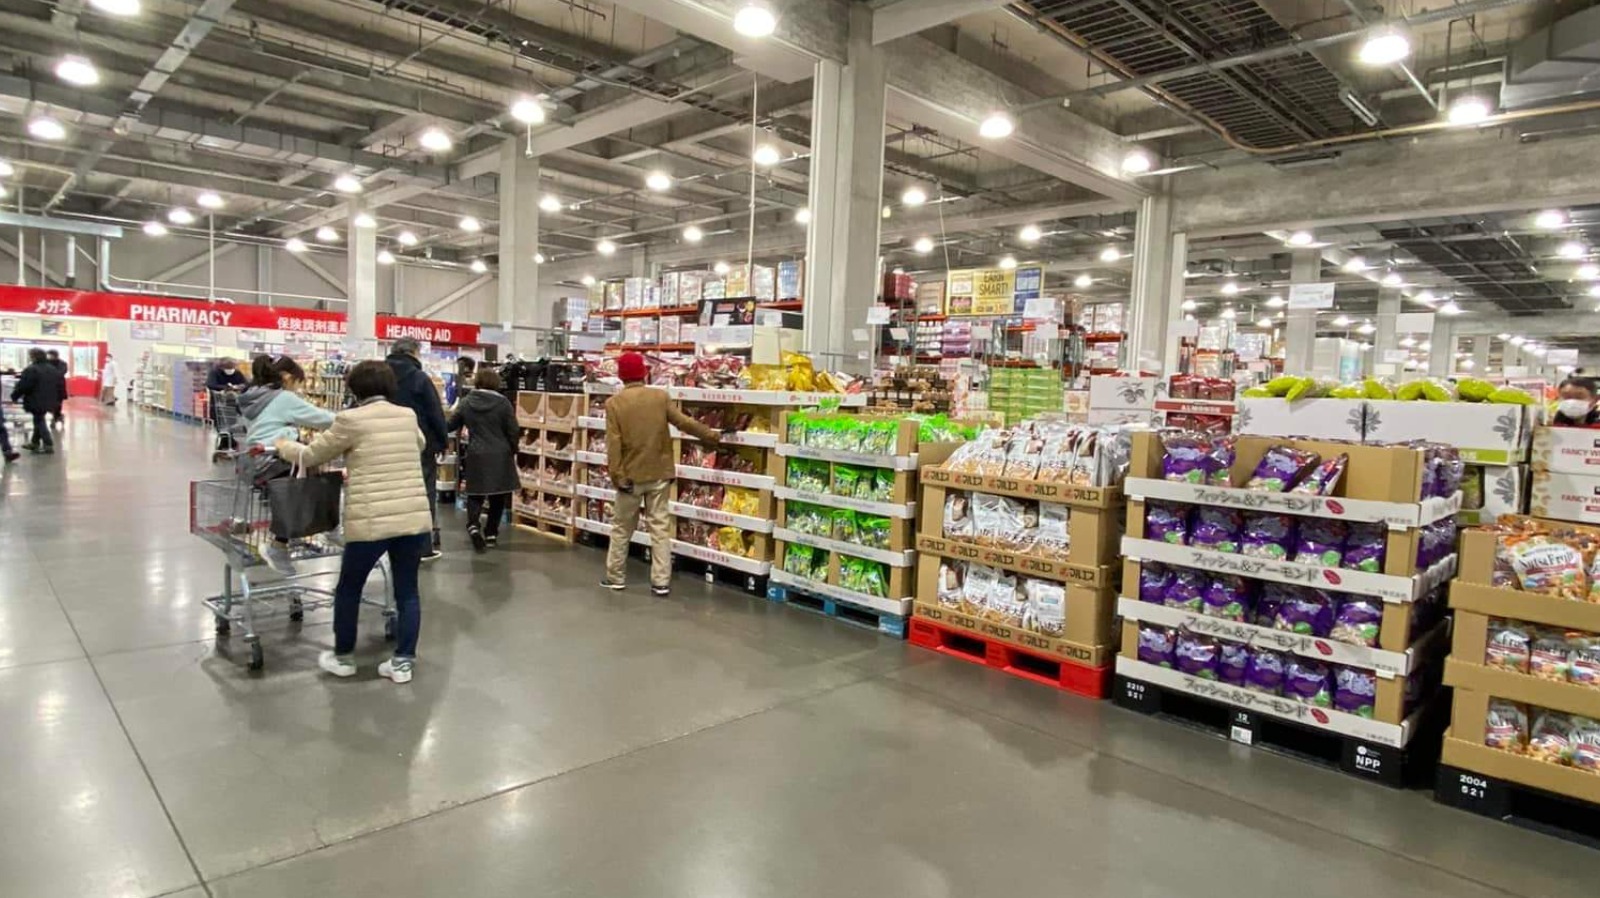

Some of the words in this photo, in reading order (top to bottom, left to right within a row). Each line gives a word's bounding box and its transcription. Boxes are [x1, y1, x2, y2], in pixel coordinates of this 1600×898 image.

[35, 299, 73, 315] メガネ
[130, 304, 232, 326] PHARMACY
[386, 324, 433, 341] HEARING
[434, 328, 451, 342] AID
[1561, 448, 1588, 457] FANCY
[1561, 494, 1588, 503] FANCY
[1356, 755, 1381, 768] NPP
[1459, 774, 1487, 788] 2004
